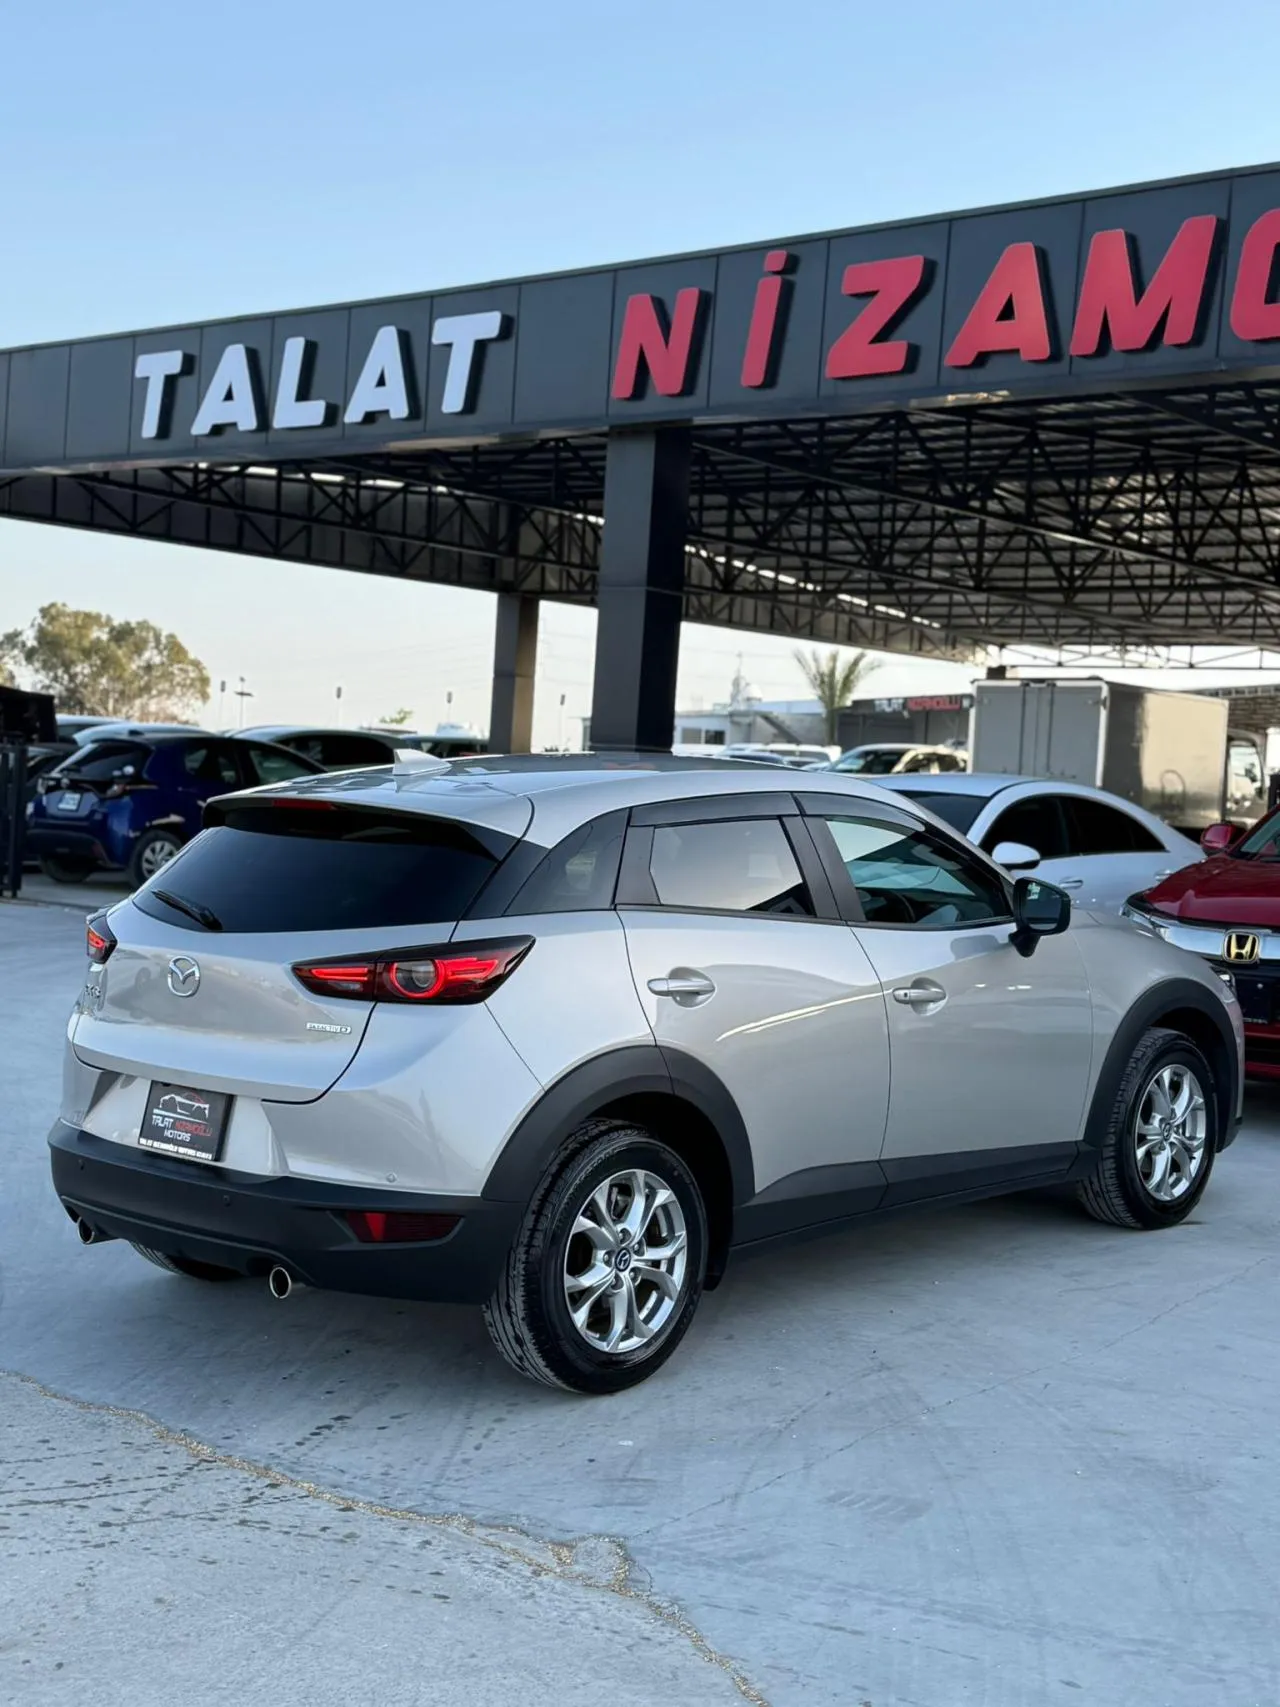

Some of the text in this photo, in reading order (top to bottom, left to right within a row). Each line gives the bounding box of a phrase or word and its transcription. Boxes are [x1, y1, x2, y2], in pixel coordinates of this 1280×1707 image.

[135, 311, 502, 439] TALAT
[152, 1115, 174, 1129] TALAT
[164, 1129, 191, 1142] MOTORS
